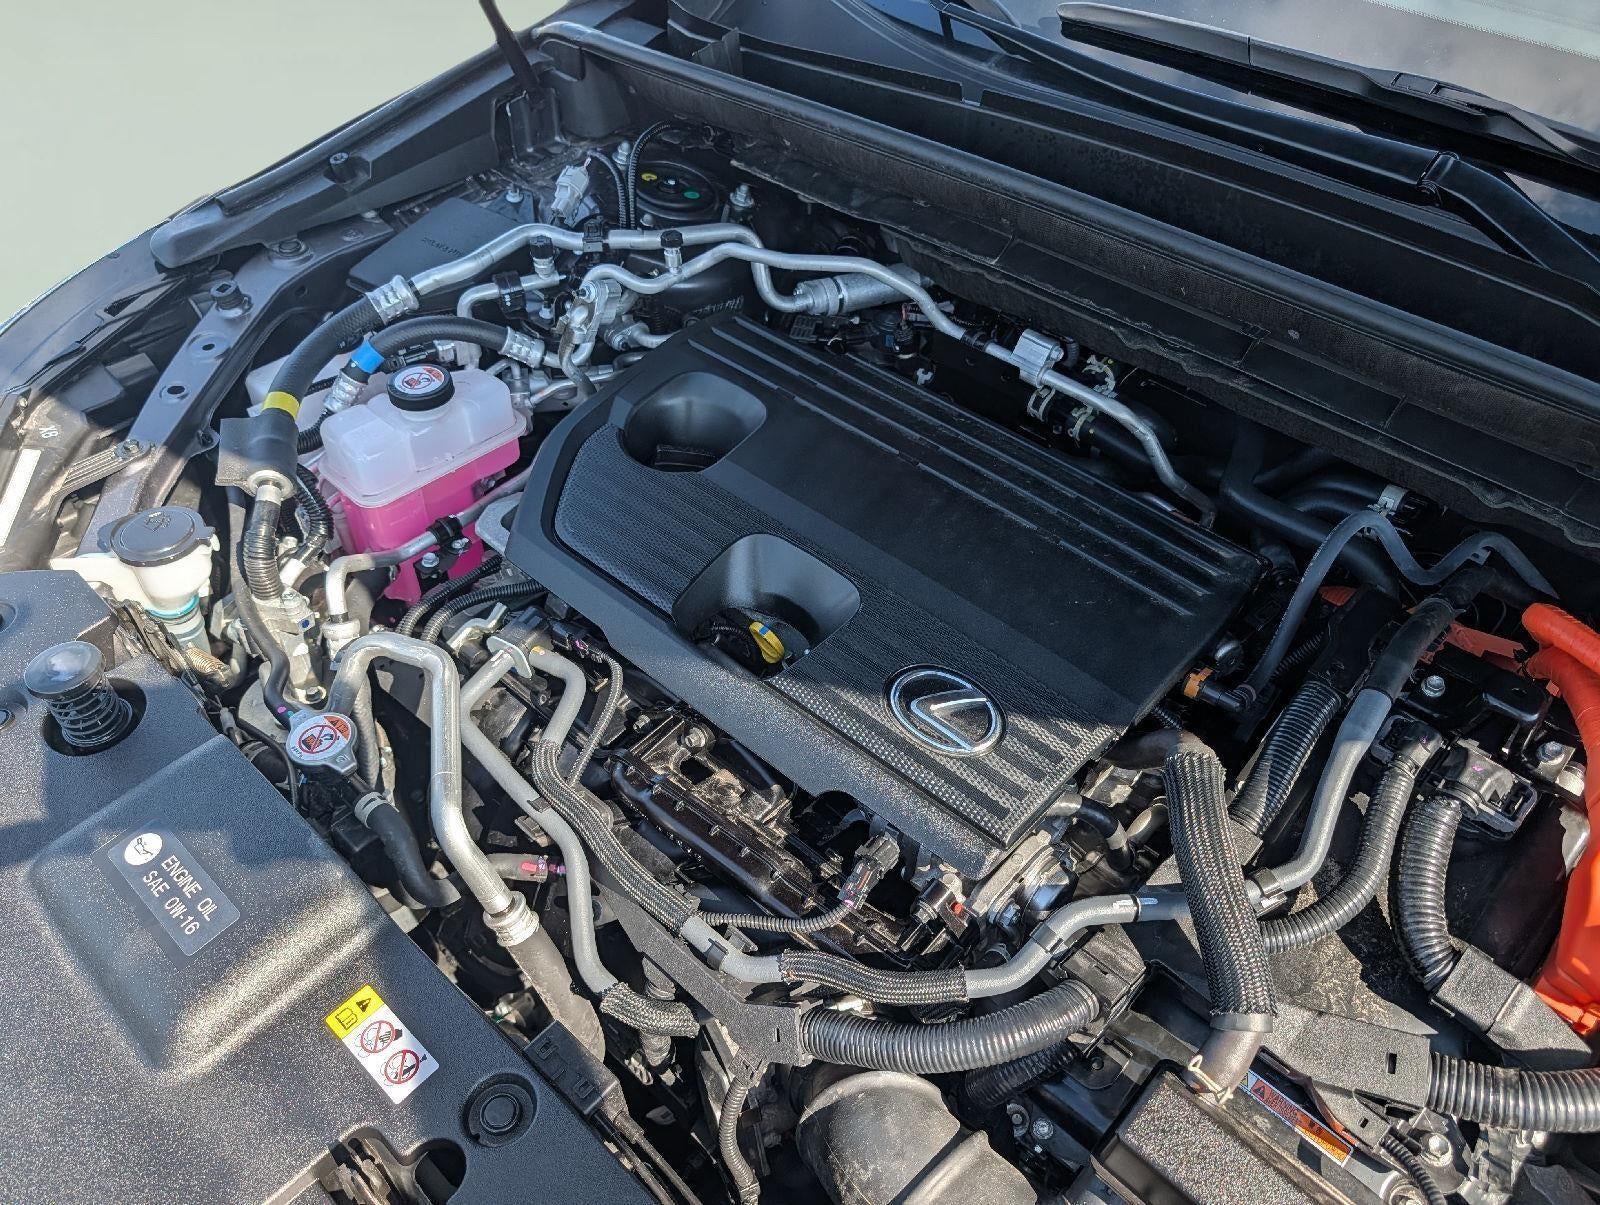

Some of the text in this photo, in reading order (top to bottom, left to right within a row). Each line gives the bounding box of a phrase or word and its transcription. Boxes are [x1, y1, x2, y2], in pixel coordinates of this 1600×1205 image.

[142, 870, 171, 898] SAE
[161, 855, 218, 922] ENGINE OIL
